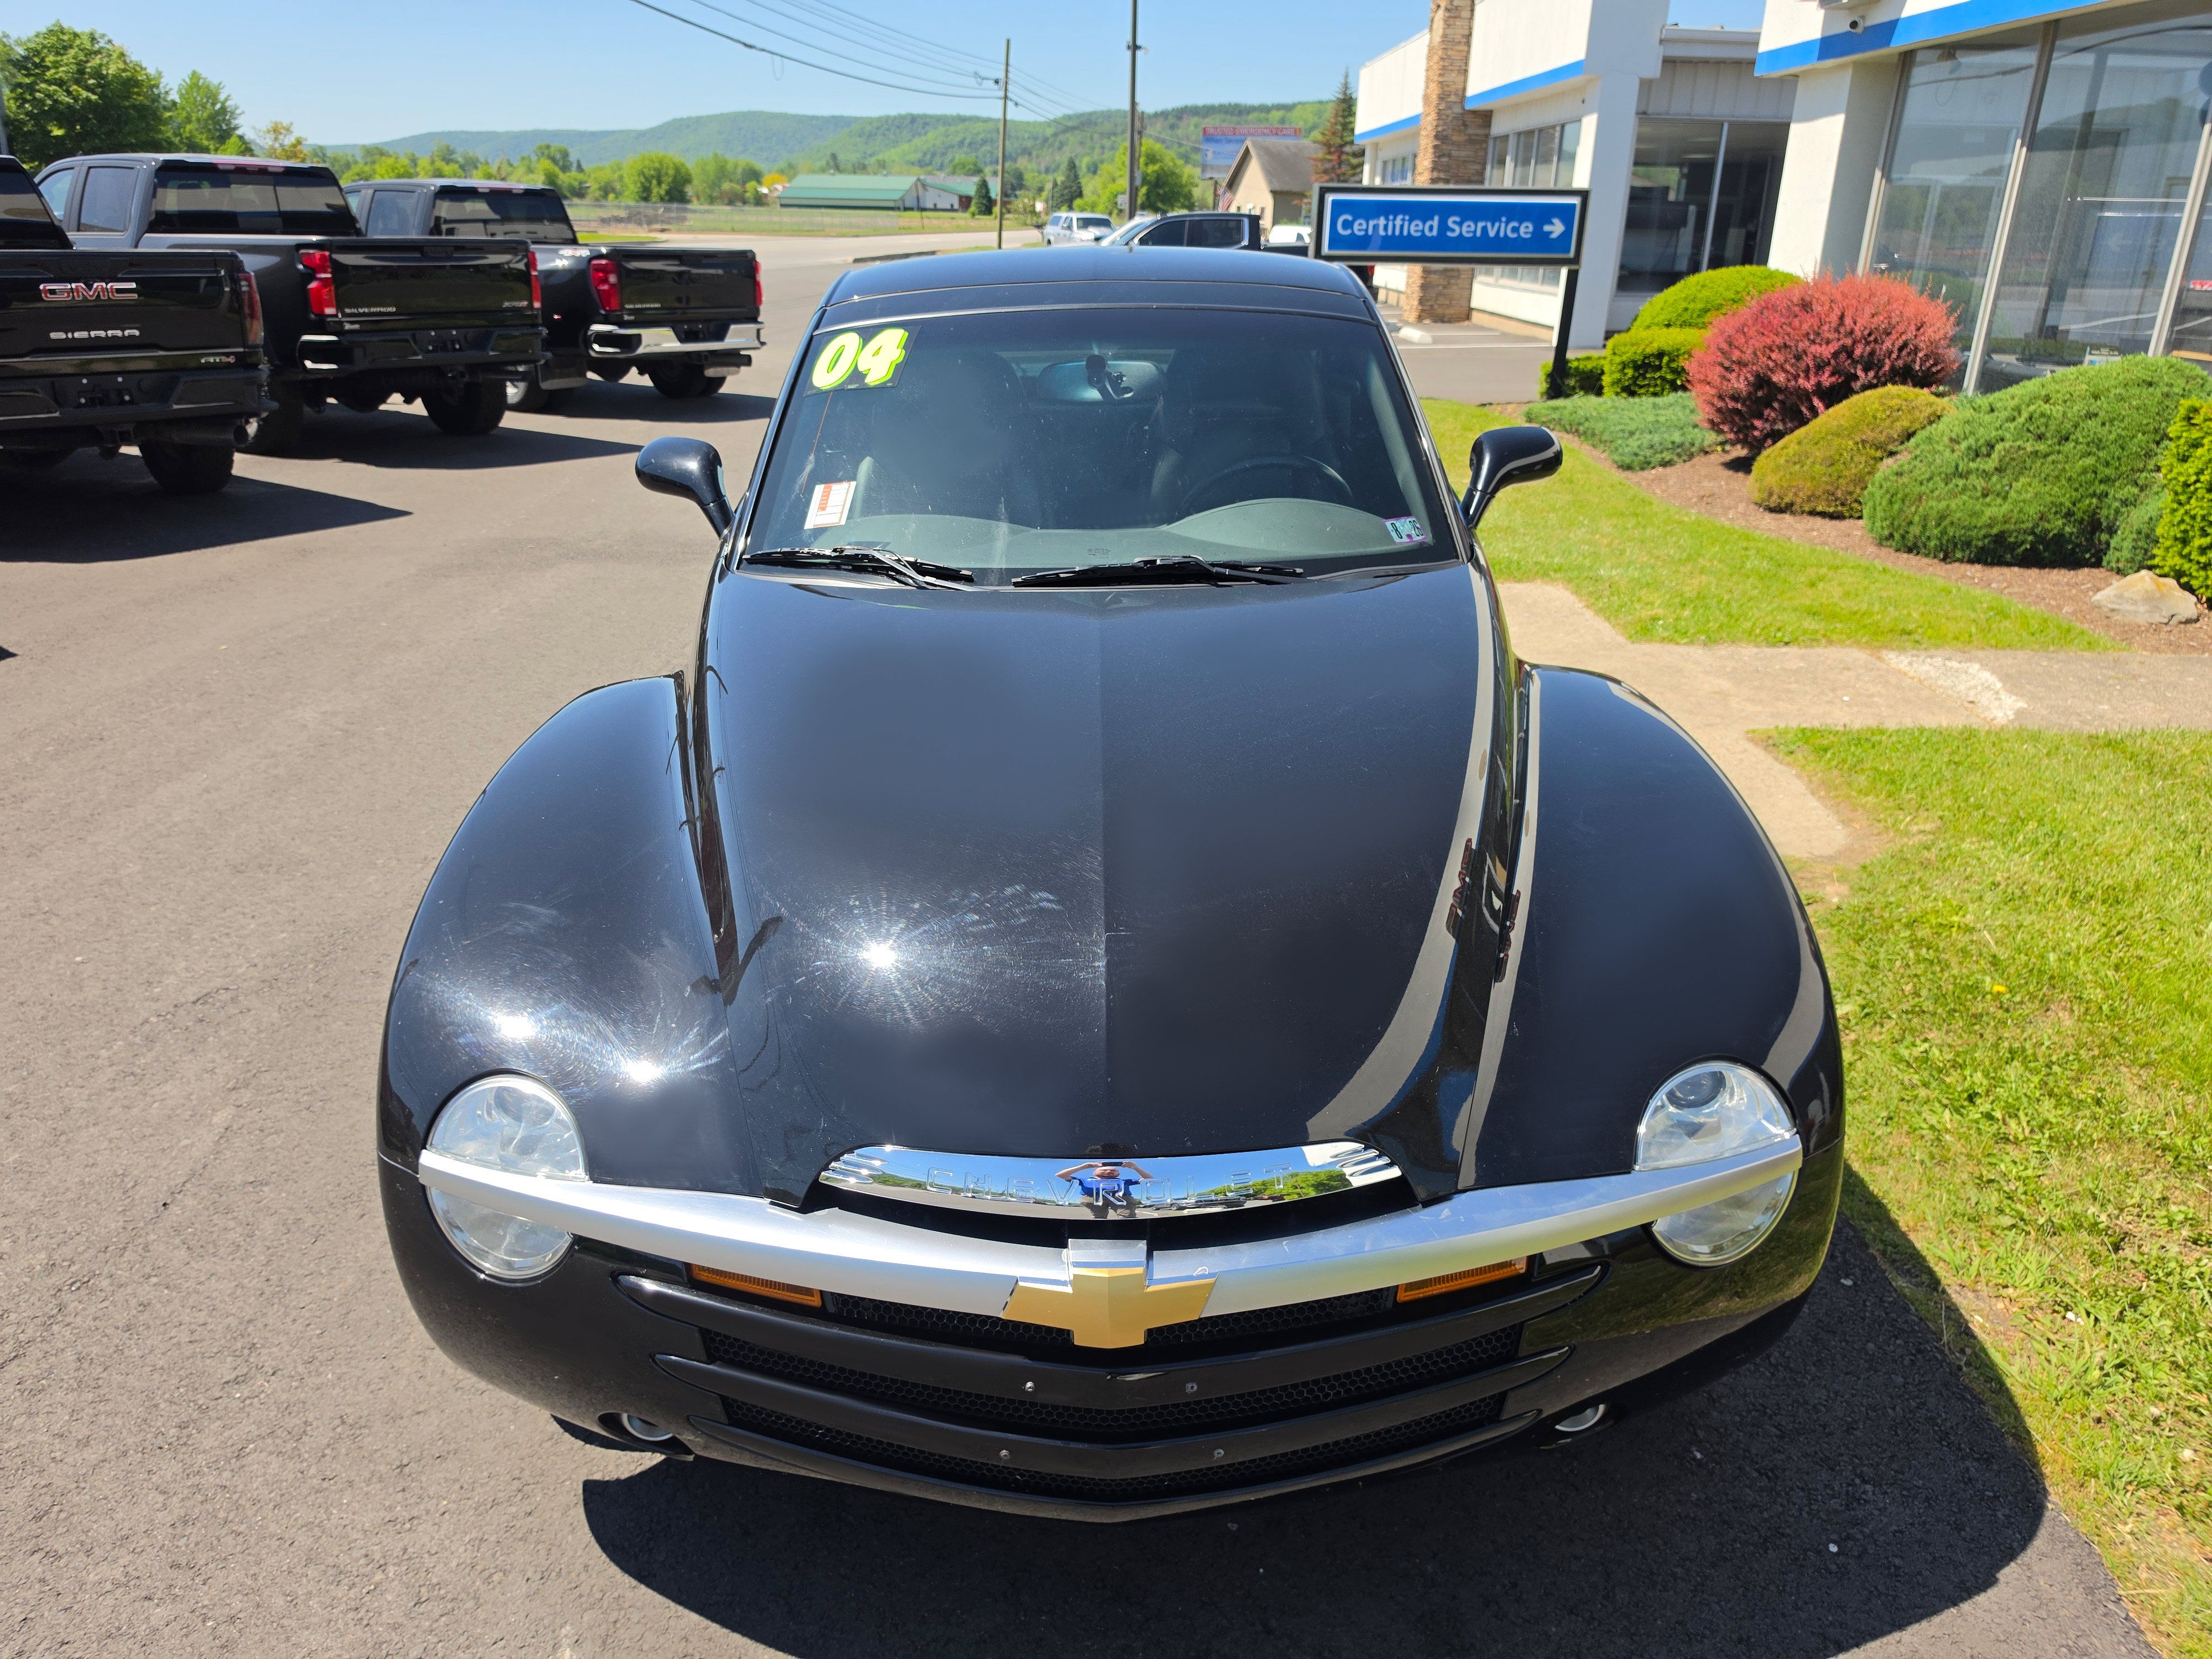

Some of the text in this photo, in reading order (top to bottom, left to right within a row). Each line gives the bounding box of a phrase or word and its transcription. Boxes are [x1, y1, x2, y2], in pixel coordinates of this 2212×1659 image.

[1336, 213, 1534, 238] Certified Service
[39, 282, 138, 301] GMC
[49, 330, 140, 339] SIERRA
[811, 327, 909, 390] 04
[1390, 520, 1424, 539] 8 26
[927, 1163, 1292, 1206] CHEVROLET
